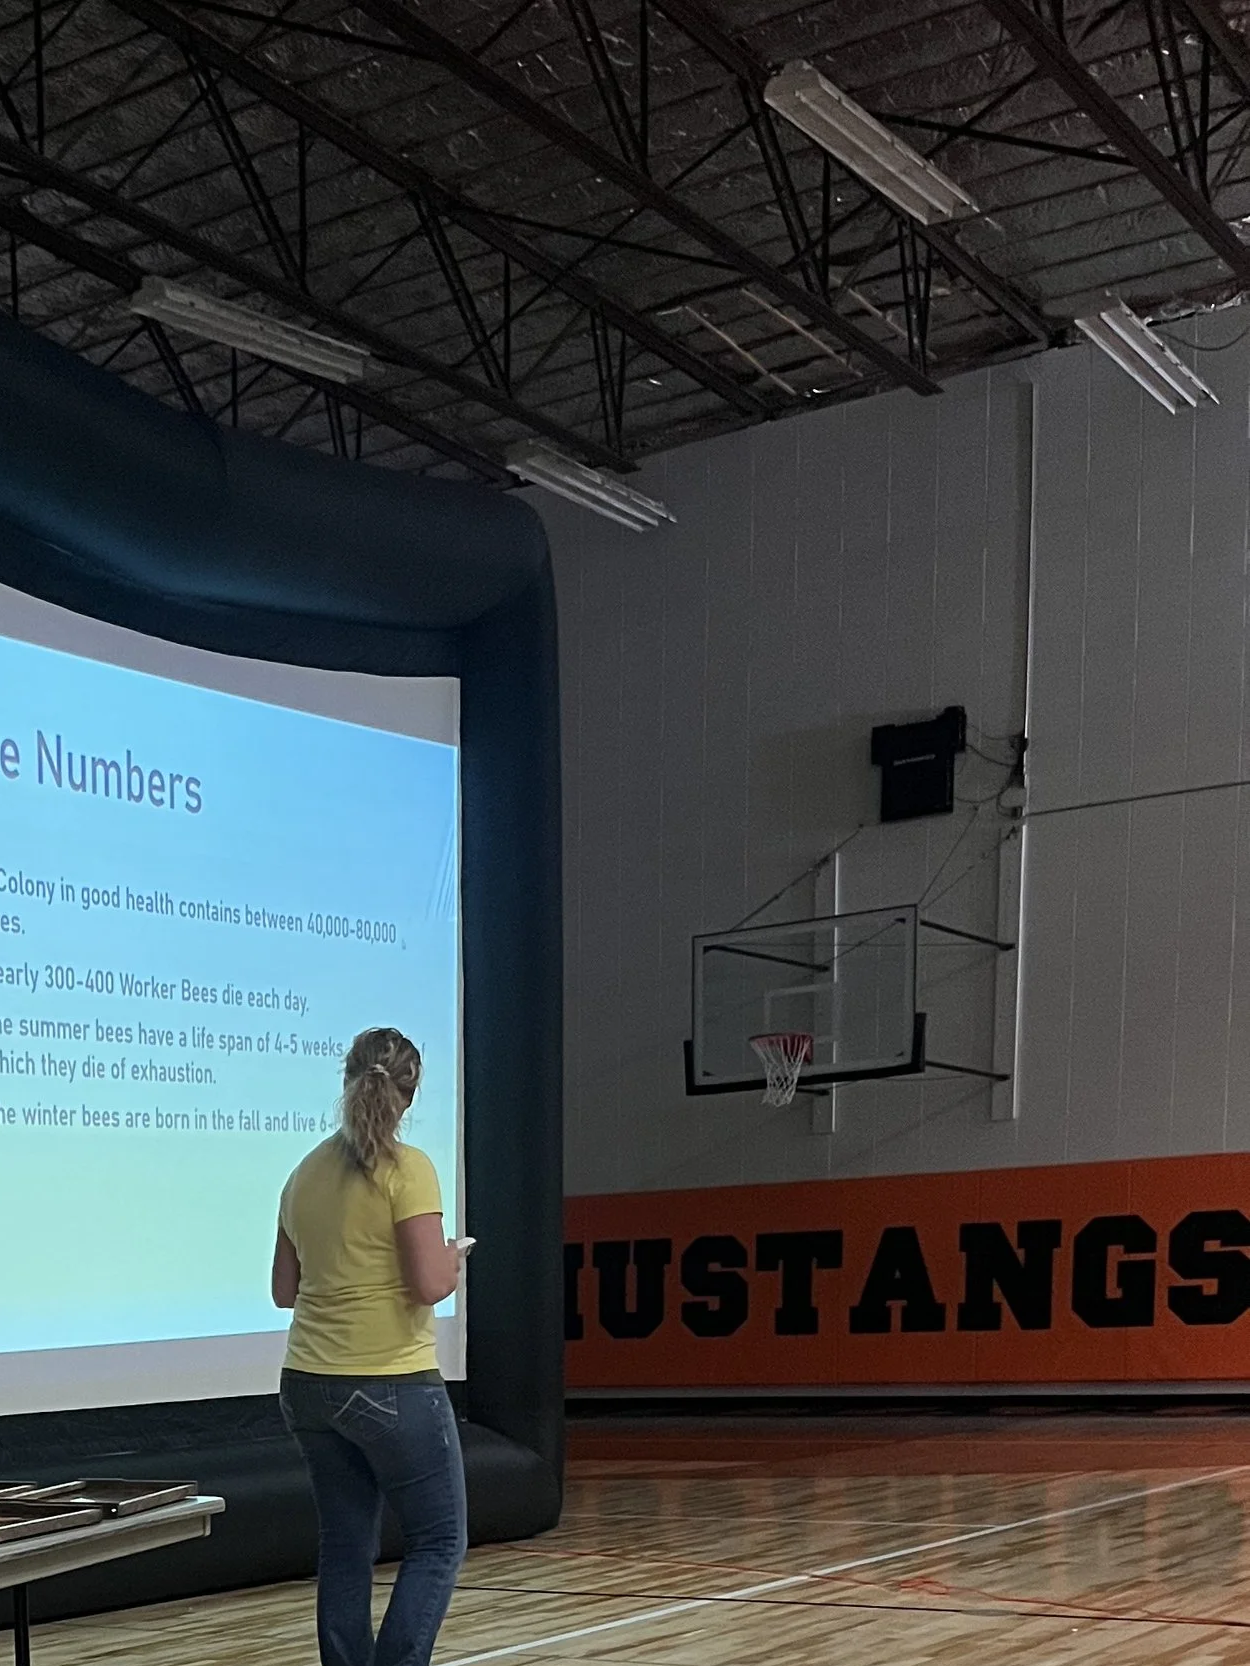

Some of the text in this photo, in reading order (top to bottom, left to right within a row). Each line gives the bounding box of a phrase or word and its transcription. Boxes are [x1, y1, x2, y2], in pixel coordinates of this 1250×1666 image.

[36, 729, 202, 815] Numbers
[60, 876, 75, 902] in
[81, 885, 120, 911] good
[125, 886, 174, 916] health
[179, 899, 241, 925] contains
[245, 903, 303, 933] between
[307, 912, 397, 945] 40,000-80,000
[44, 964, 115, 995] 300-400
[119, 970, 177, 1000] Worker
[181, 977, 218, 1004] Bees
[222, 984, 243, 1007] die
[248, 987, 281, 1010] each
[284, 991, 310, 1017] day.
[18, 1017, 90, 1042] summer
[95, 1018, 134, 1044] bees
[138, 1021, 174, 1047] have
[178, 1030, 188, 1048] a
[191, 1026, 215, 1050] life
[219, 1032, 253, 1057] span
[257, 1030, 271, 1053] of
[274, 1032, 298, 1055] 4-5
[41, 1052, 77, 1084] they
[82, 1054, 106, 1079] die
[111, 1056, 126, 1080] of
[130, 1058, 217, 1085] exhaustion.
[22, 1102, 77, 1127] winter
[82, 1103, 120, 1128] bees
[125, 1111, 151, 1130] are
[155, 1106, 190, 1131] born
[194, 1108, 208, 1131] in
[212, 1108, 234, 1131] the
[238, 1109, 261, 1132] fall
[264, 1110, 289, 1132] and
[292, 1110, 316, 1132] live
[564, 1209, 1250, 1340] USTANGS
